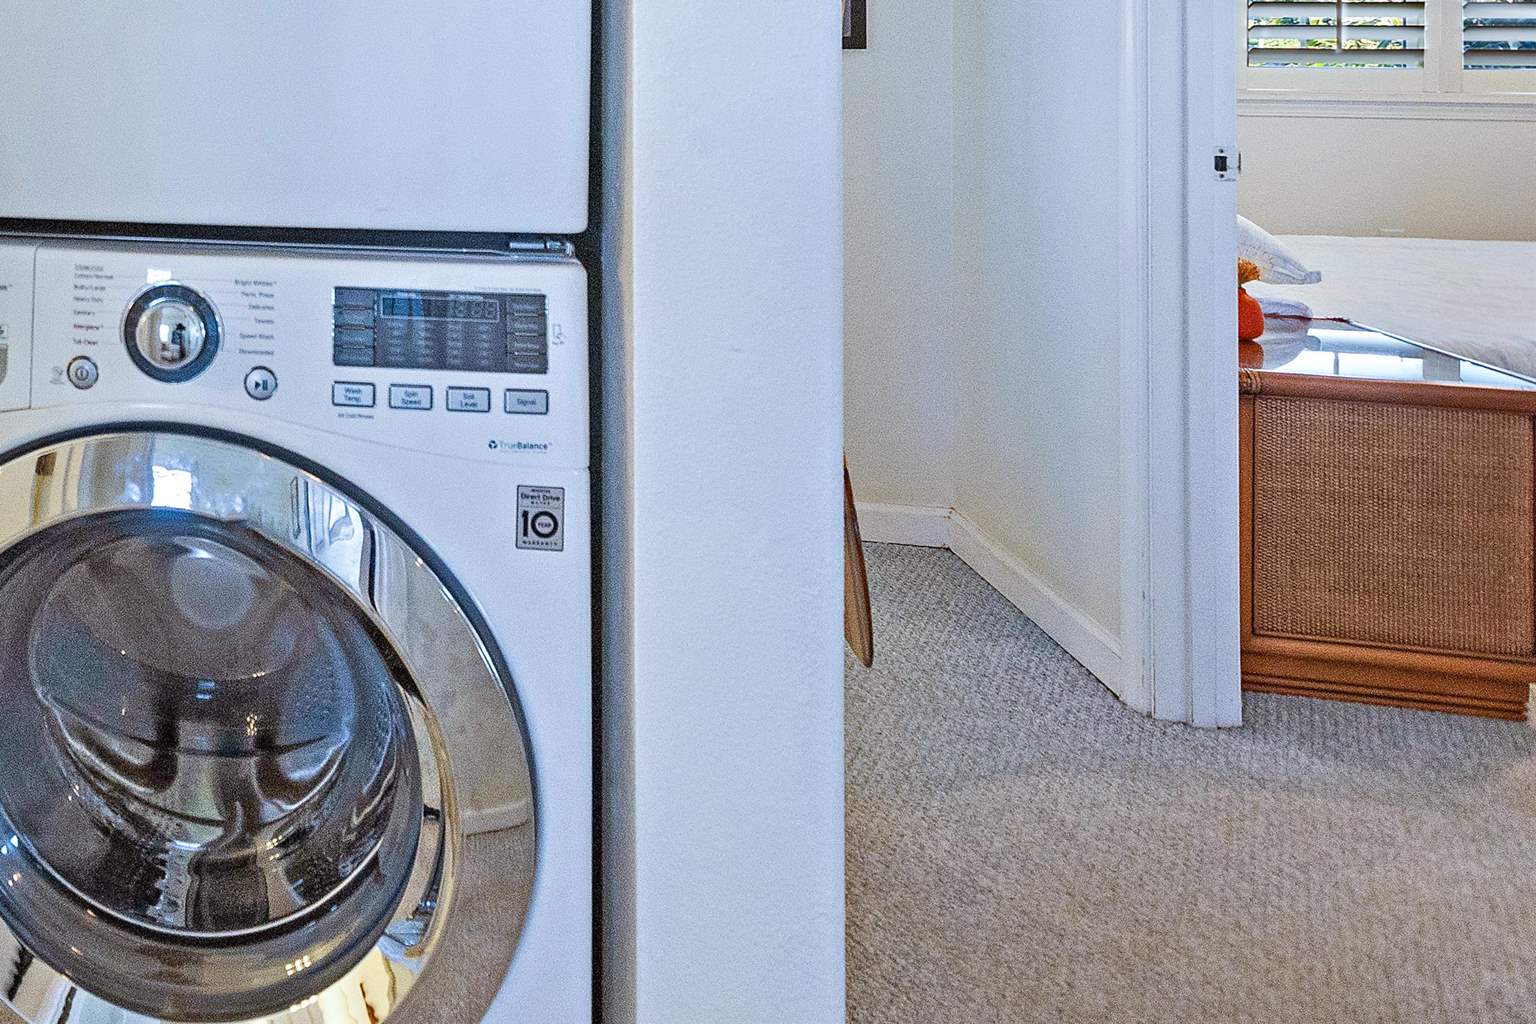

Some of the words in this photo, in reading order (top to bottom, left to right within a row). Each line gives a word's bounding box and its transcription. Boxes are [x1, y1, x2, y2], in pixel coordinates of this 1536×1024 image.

[402, 398, 421, 406] Speed
[460, 400, 478, 408] Level
[517, 398, 537, 407] Signal
[500, 441, 548, 450] TrueBalance
[521, 493, 541, 501] Direct
[542, 494, 561, 502] Drive
[522, 509, 559, 539] 10
